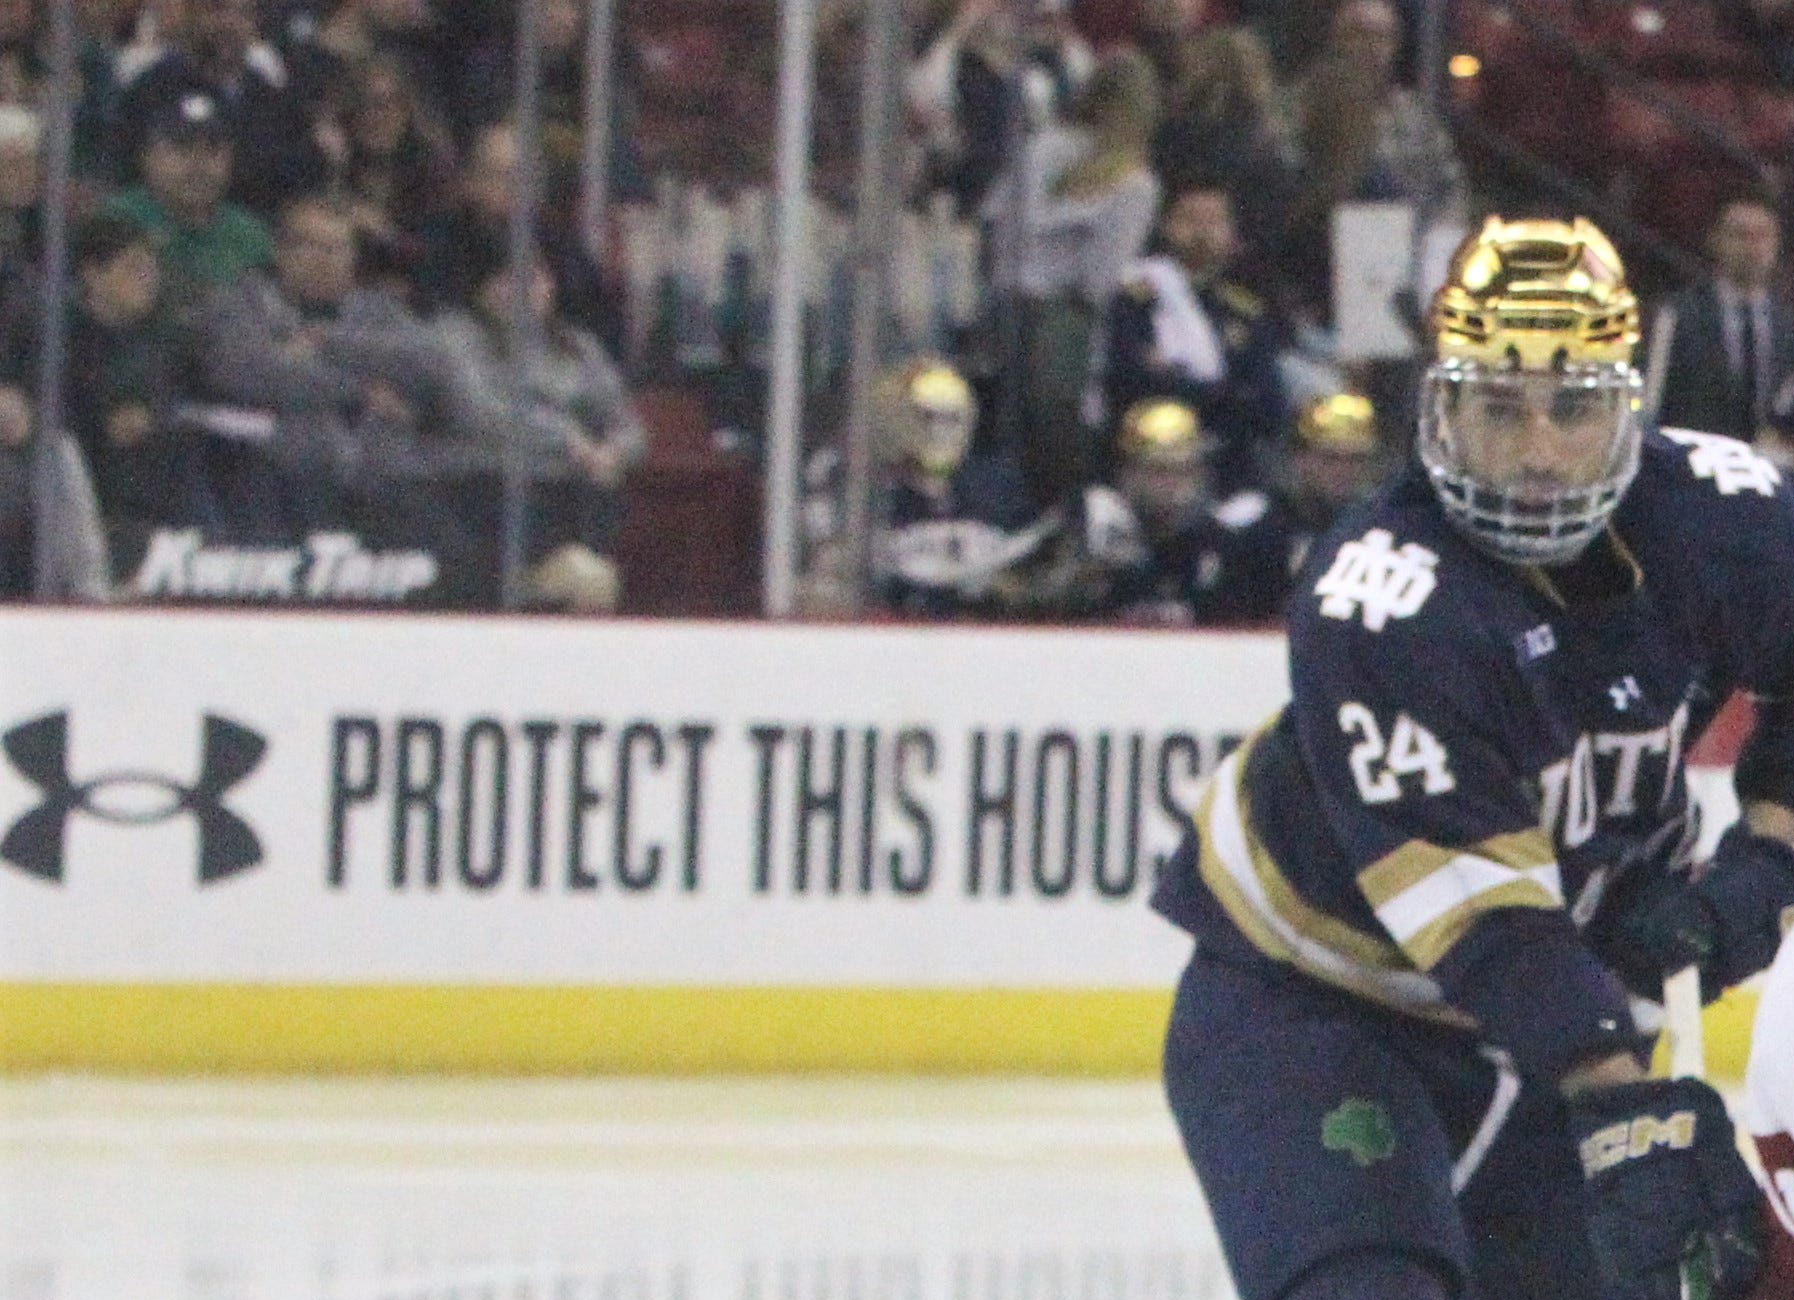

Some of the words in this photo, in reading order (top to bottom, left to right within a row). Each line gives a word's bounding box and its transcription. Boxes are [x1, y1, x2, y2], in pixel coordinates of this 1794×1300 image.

[325, 715, 715, 892] PROTECT
[748, 724, 940, 897] THIS
[964, 727, 1243, 900] HOUS
[1338, 701, 1456, 804] 24
